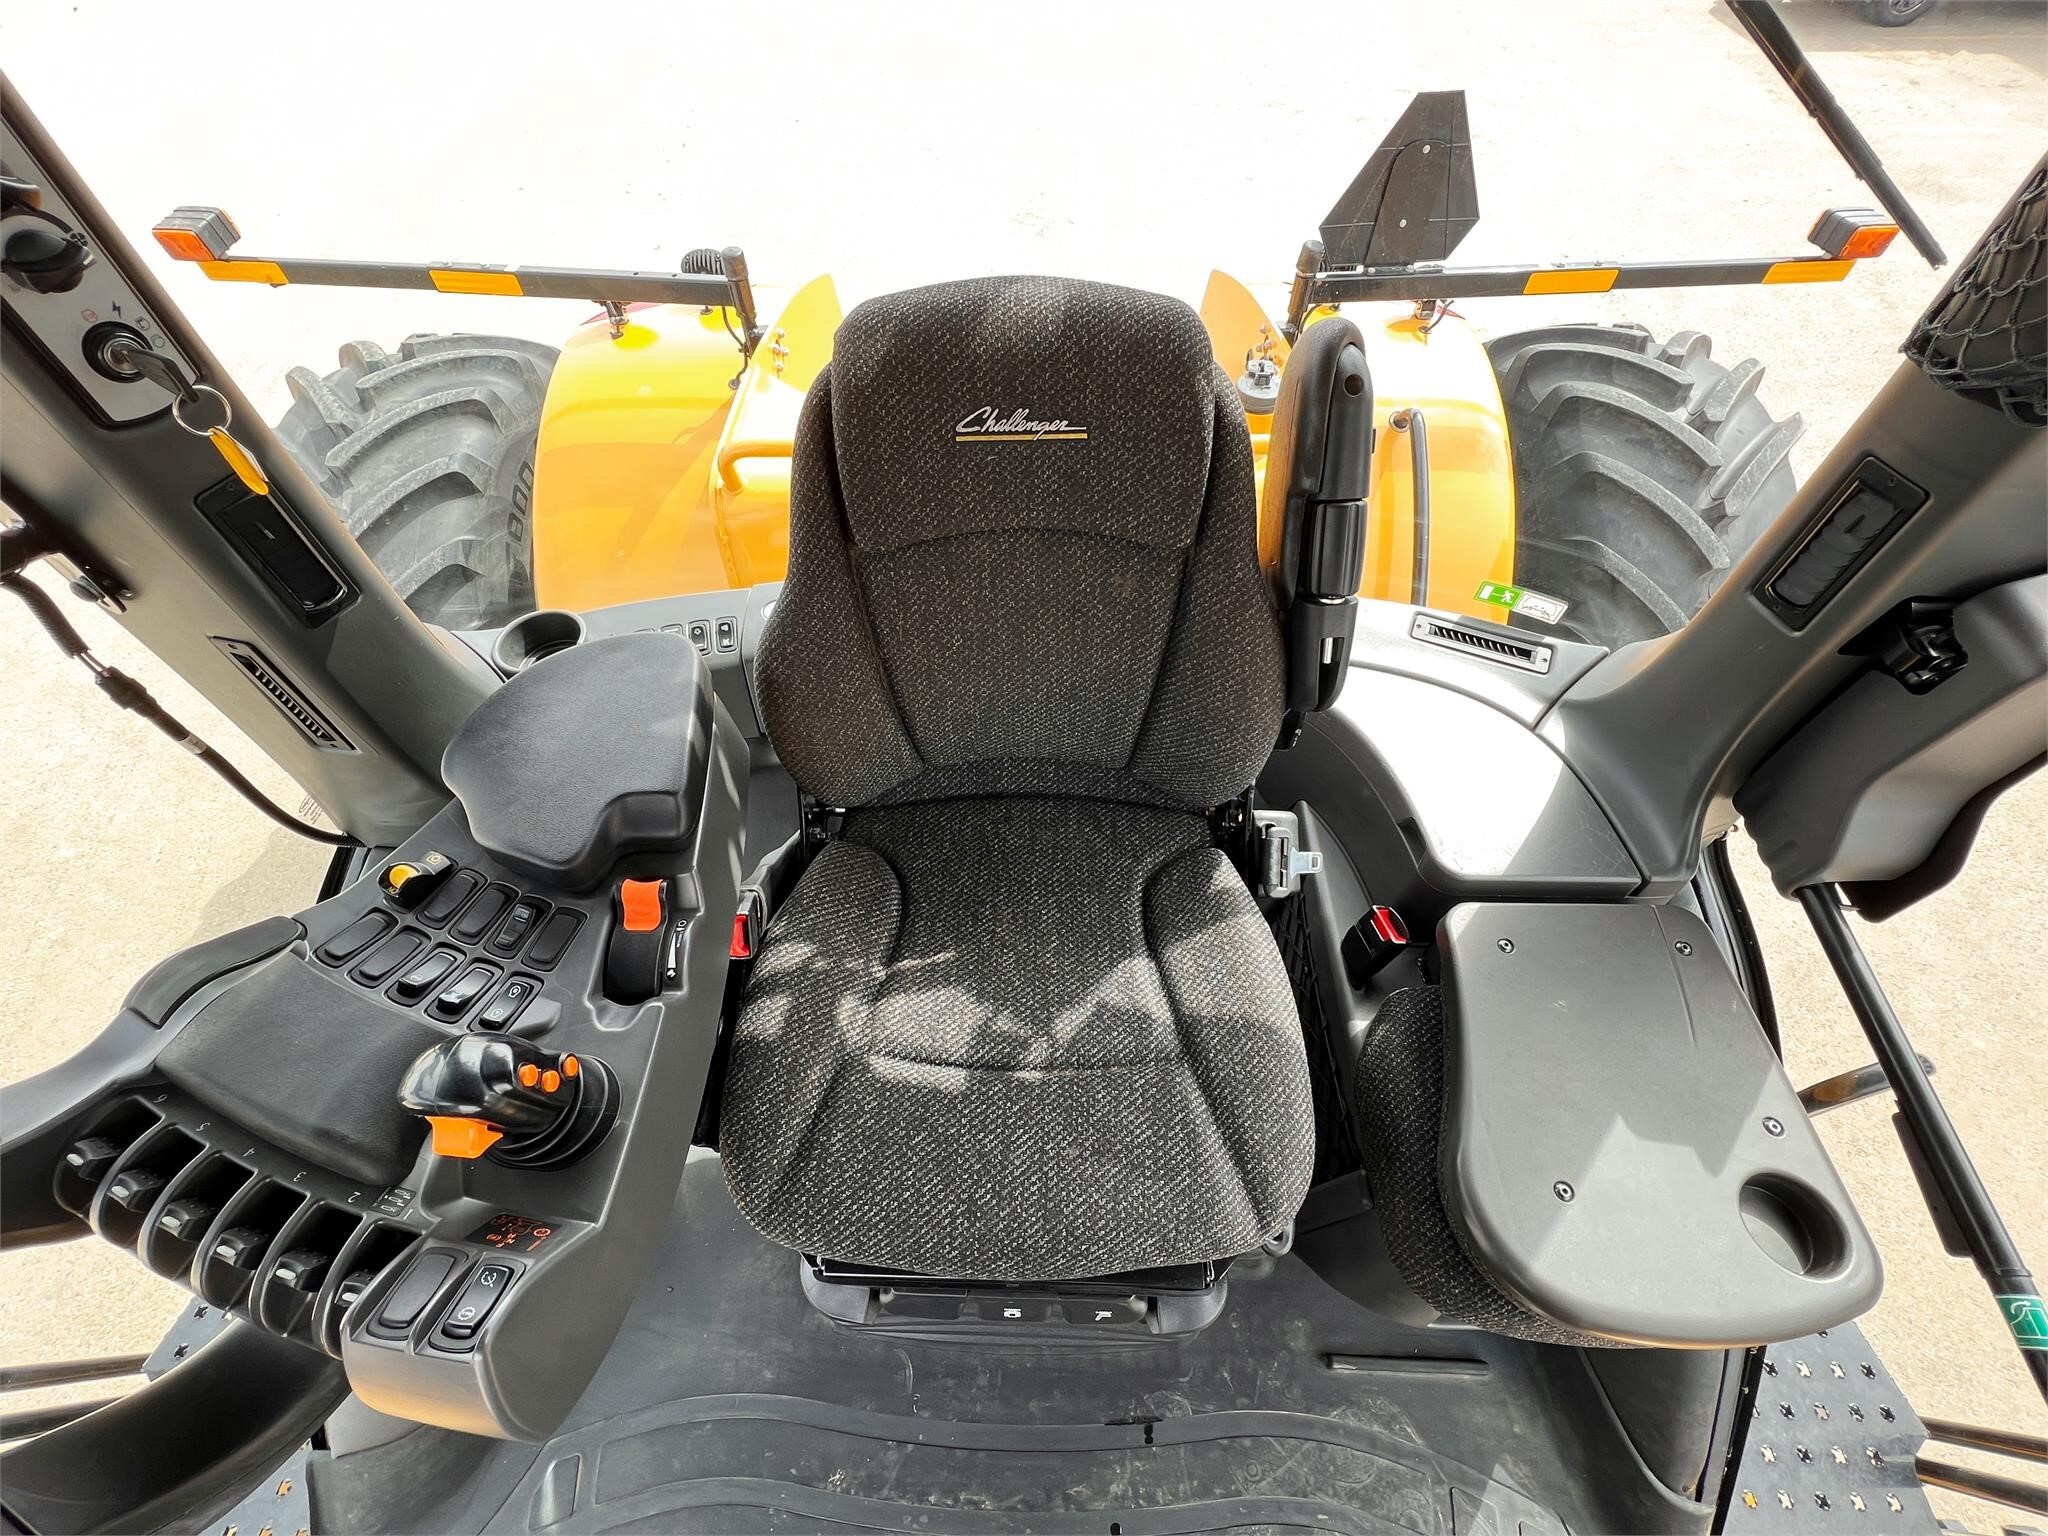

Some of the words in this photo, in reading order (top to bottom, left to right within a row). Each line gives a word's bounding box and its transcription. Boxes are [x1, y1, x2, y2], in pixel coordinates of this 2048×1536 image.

[956, 406, 1087, 440] Challenger
[242, 1147, 255, 1158] 4
[293, 1171, 307, 1182] 3
[347, 1191, 362, 1203] 2
